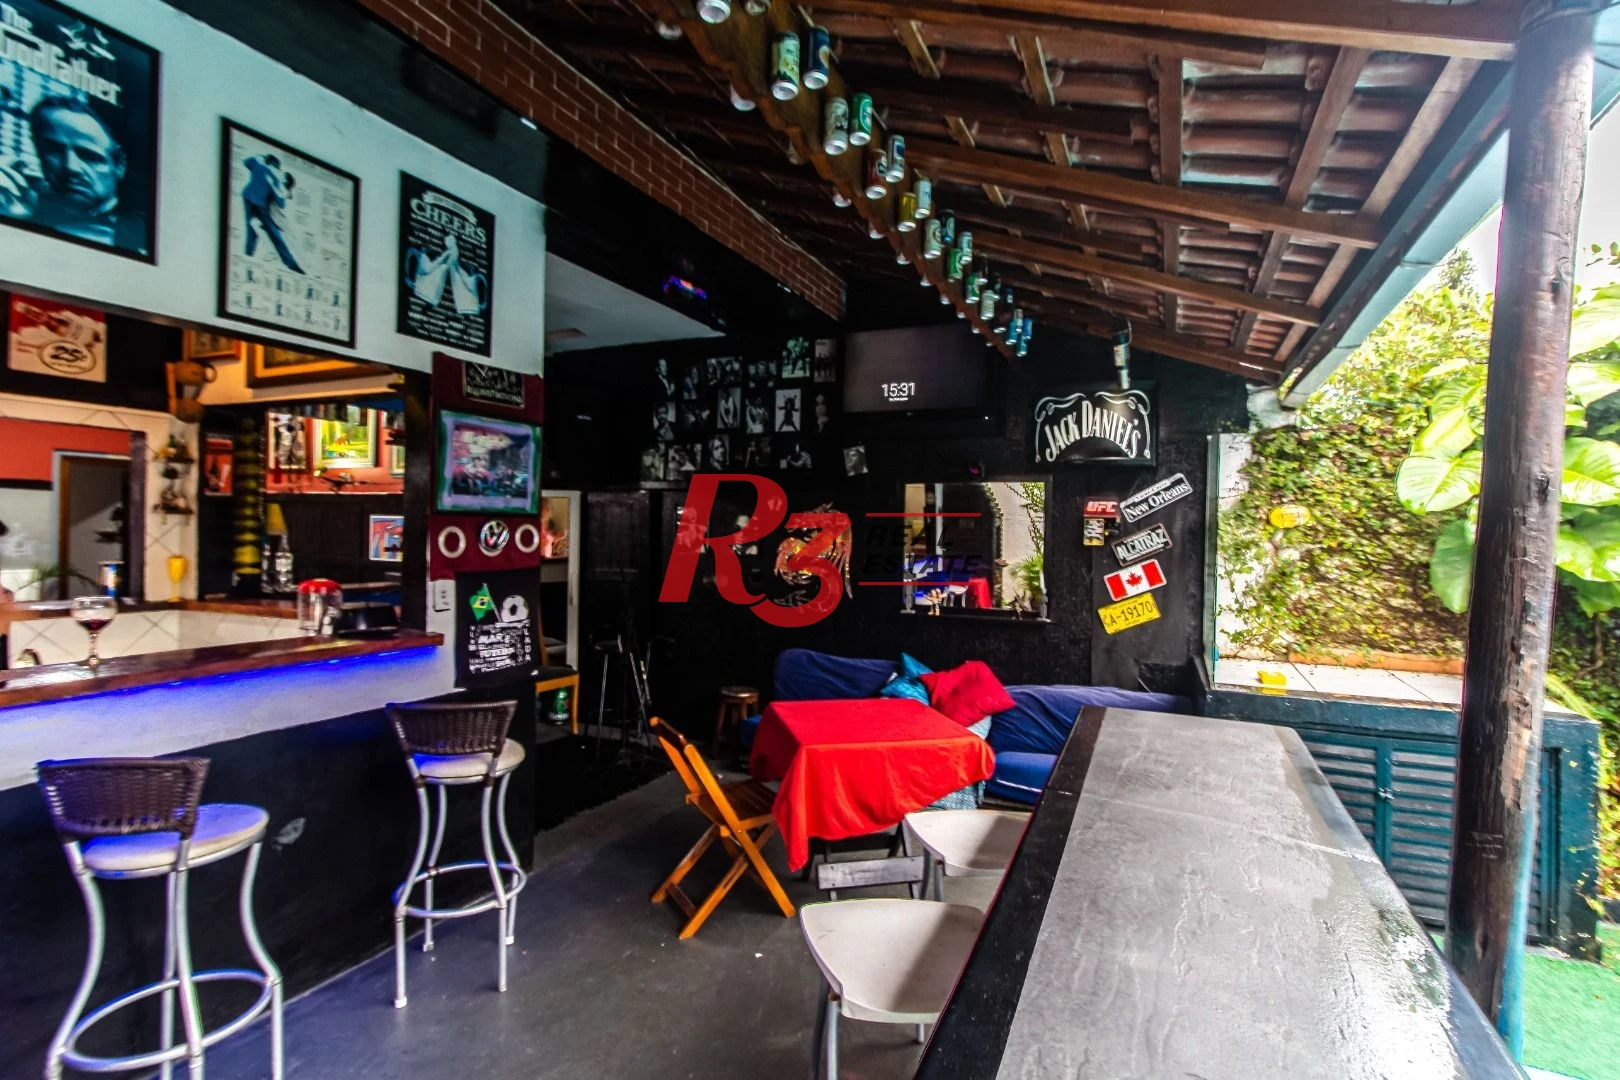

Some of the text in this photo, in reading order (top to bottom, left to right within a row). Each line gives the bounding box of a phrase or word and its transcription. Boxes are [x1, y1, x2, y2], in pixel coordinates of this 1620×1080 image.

[410, 197, 488, 244] CHEERS
[881, 382, 916, 397] 15:31
[1045, 400, 1142, 462] JACK DANIEL'S
[1086, 501, 1118, 513] UFC
[1125, 482, 1189, 520] New Orleans
[1115, 529, 1168, 560] ALCATRAZ
